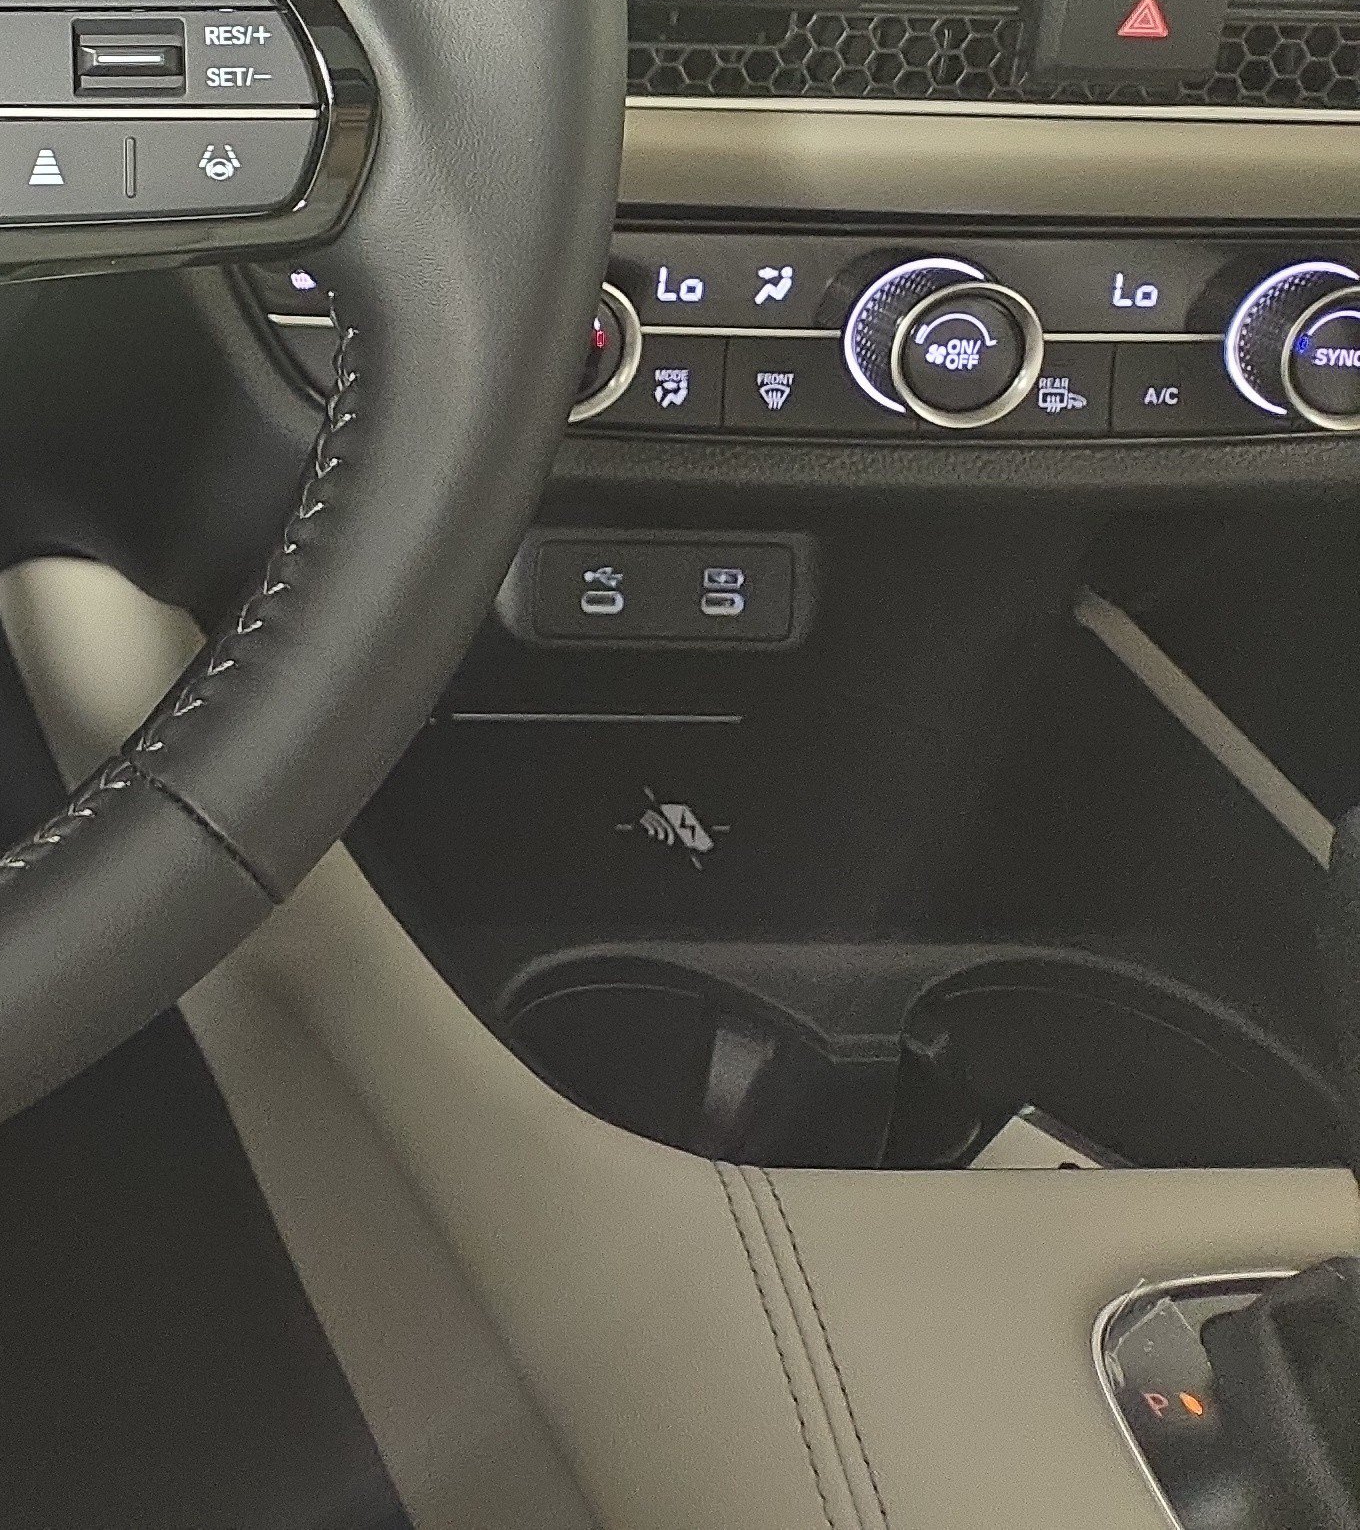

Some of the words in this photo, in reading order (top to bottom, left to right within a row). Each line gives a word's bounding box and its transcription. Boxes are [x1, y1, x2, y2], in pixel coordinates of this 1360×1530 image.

[204, 26, 271, 46] RES/+
[947, 339, 981, 356] ON/
[945, 354, 980, 370] OFF
[655, 369, 689, 382] MODE
[757, 372, 795, 385] FRONT
[1039, 377, 1069, 389] REAR
[1144, 387, 1179, 406] A/C
